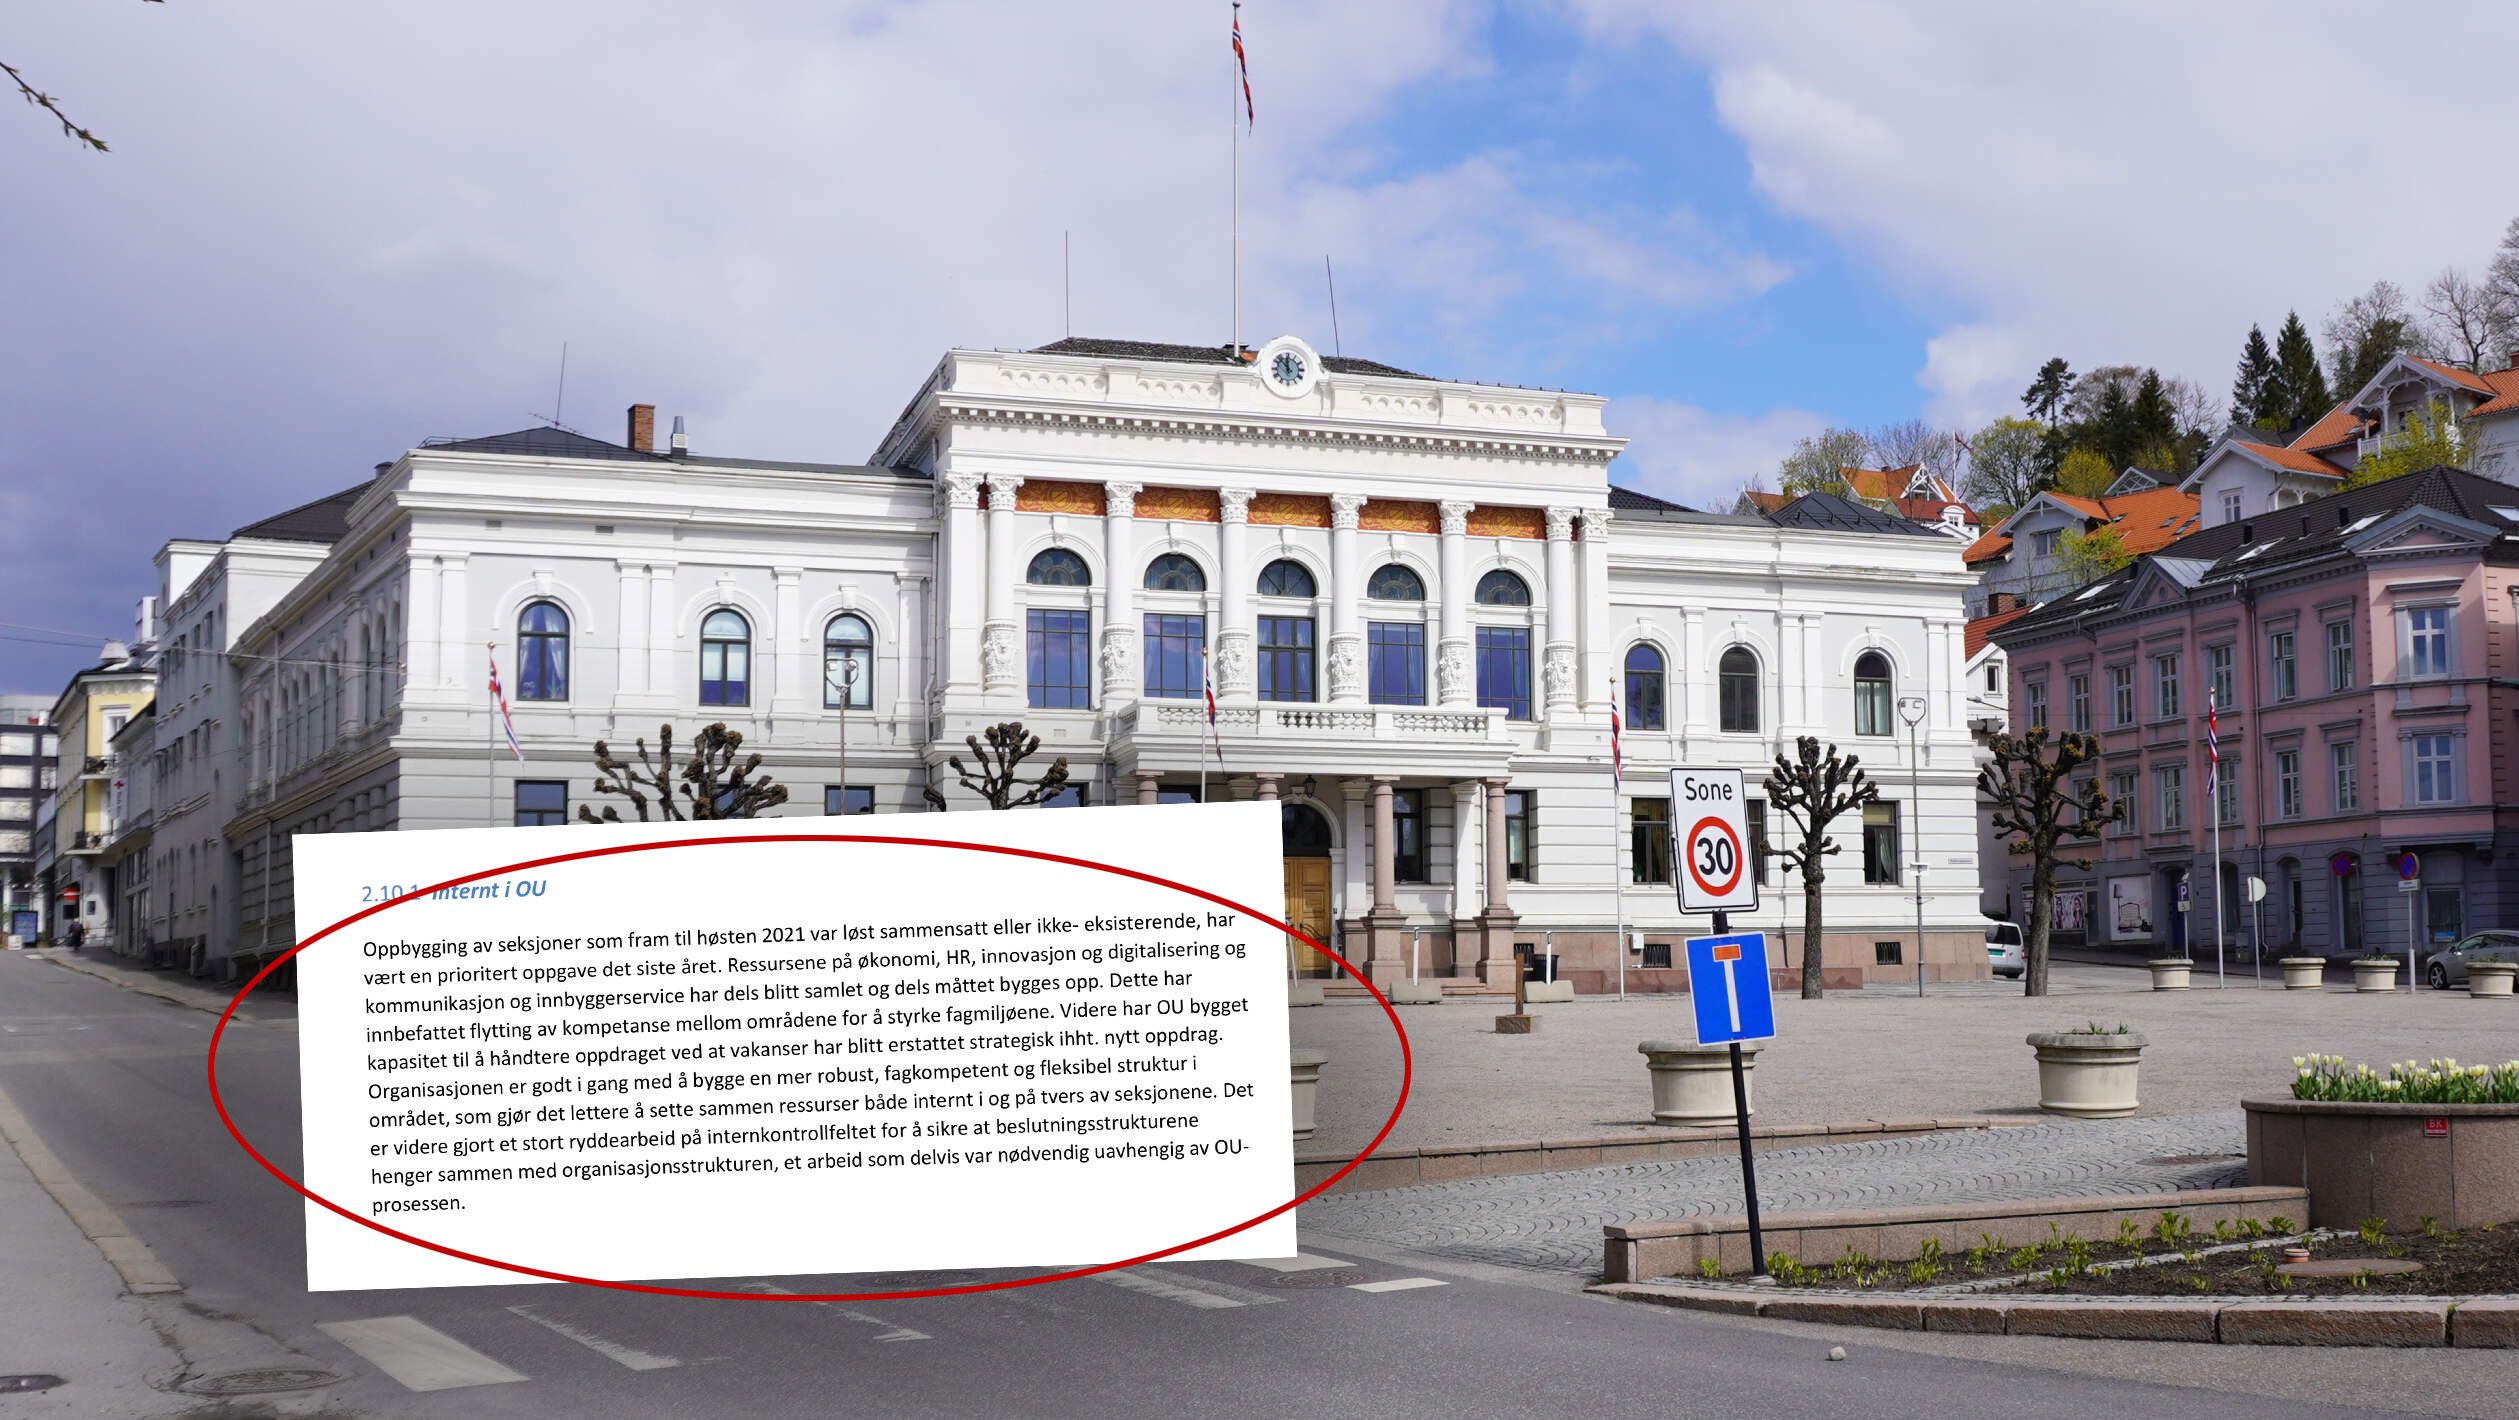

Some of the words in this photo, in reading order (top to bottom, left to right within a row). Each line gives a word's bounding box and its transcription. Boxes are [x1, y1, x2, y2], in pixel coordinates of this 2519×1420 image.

[1685, 777, 1733, 801] Sone
[1697, 837, 1734, 876] 30
[2180, 886, 2187, 900] P
